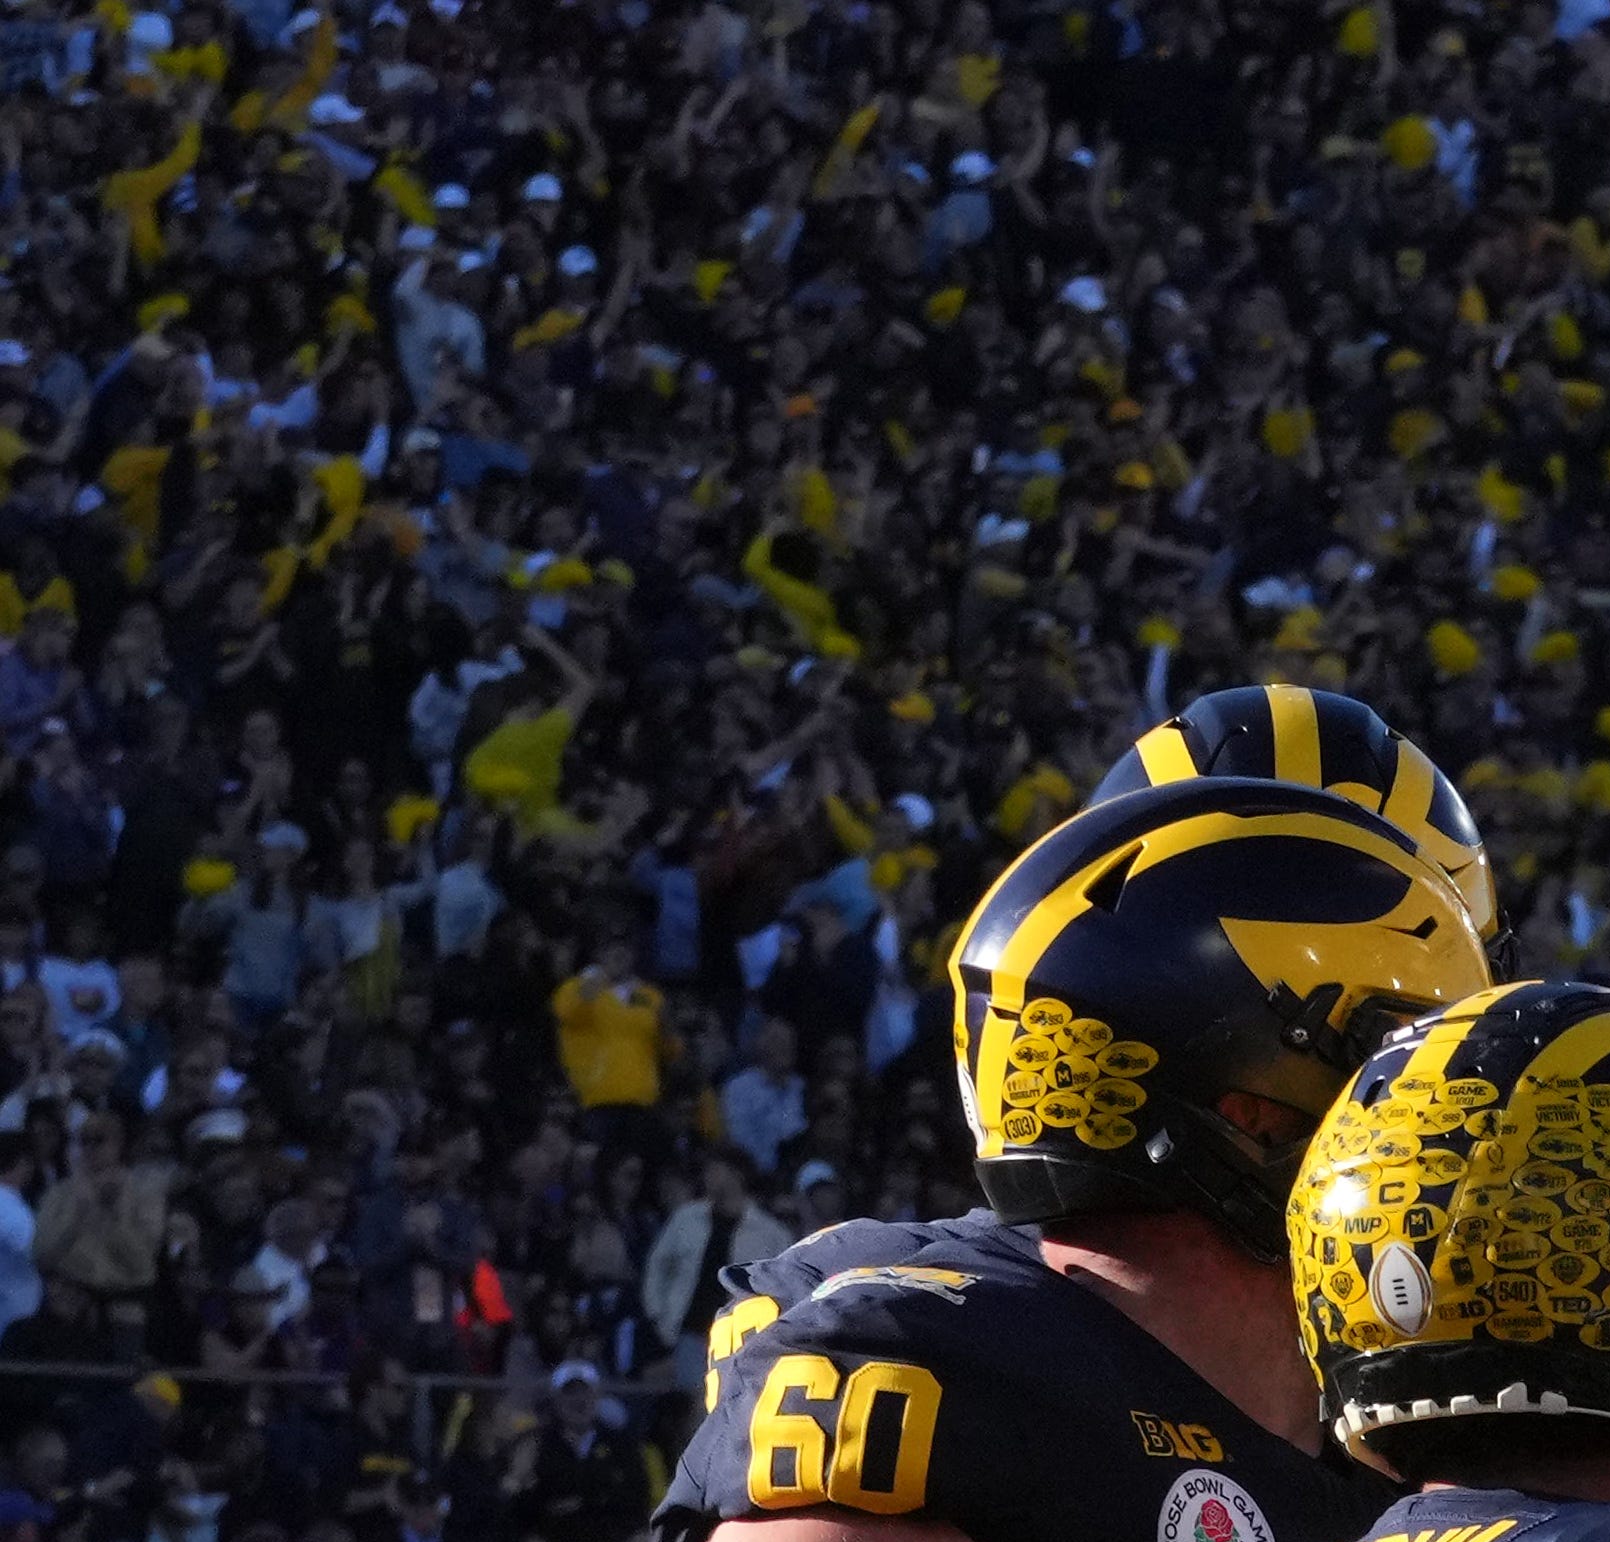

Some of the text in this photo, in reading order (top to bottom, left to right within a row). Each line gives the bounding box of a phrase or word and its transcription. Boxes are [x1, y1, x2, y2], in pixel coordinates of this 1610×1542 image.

[1449, 1085, 1487, 1096] GAME
[1344, 1217, 1381, 1234] MVP
[748, 1355, 943, 1515] 60
[1183, 1477, 1230, 1501] BOWL
